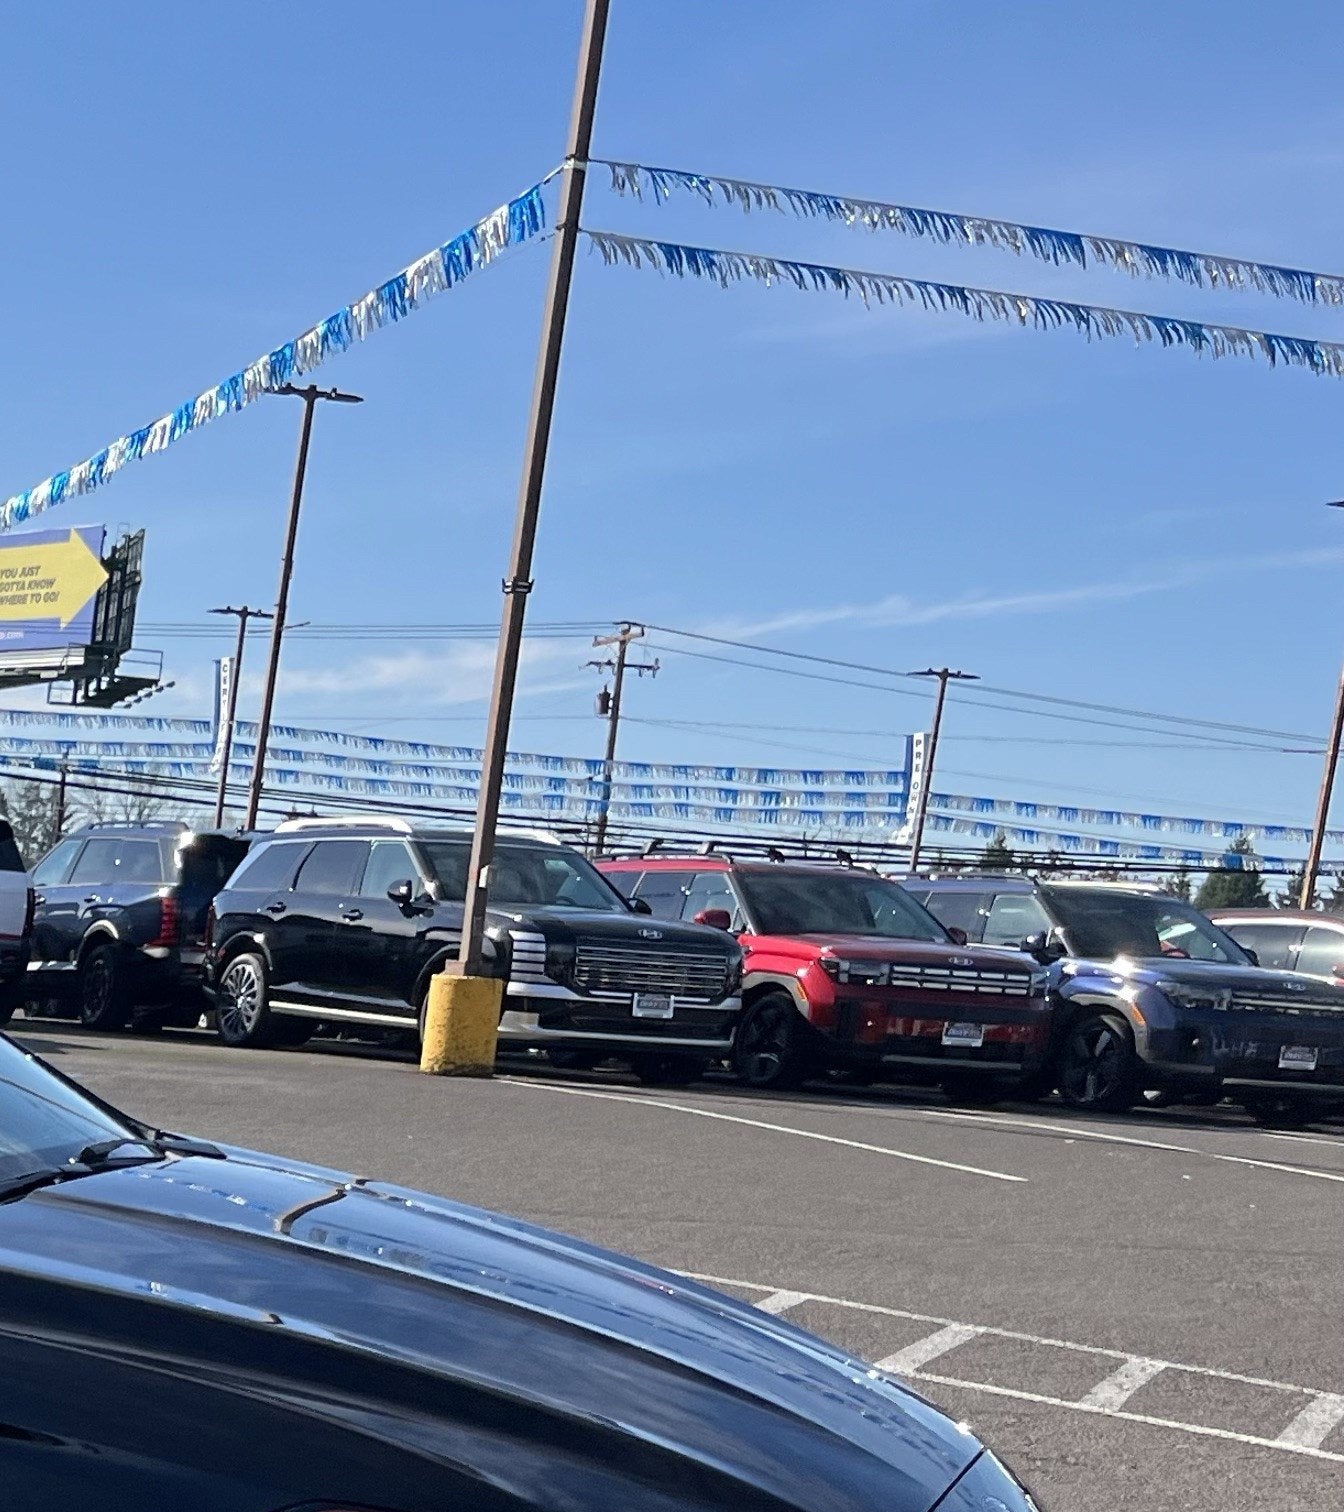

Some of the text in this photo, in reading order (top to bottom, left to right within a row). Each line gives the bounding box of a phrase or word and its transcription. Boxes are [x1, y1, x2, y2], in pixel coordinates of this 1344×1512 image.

[0, 565, 41, 579] YOU JUST
[26, 577, 56, 591] KNOW
[30, 592, 42, 604] TO
